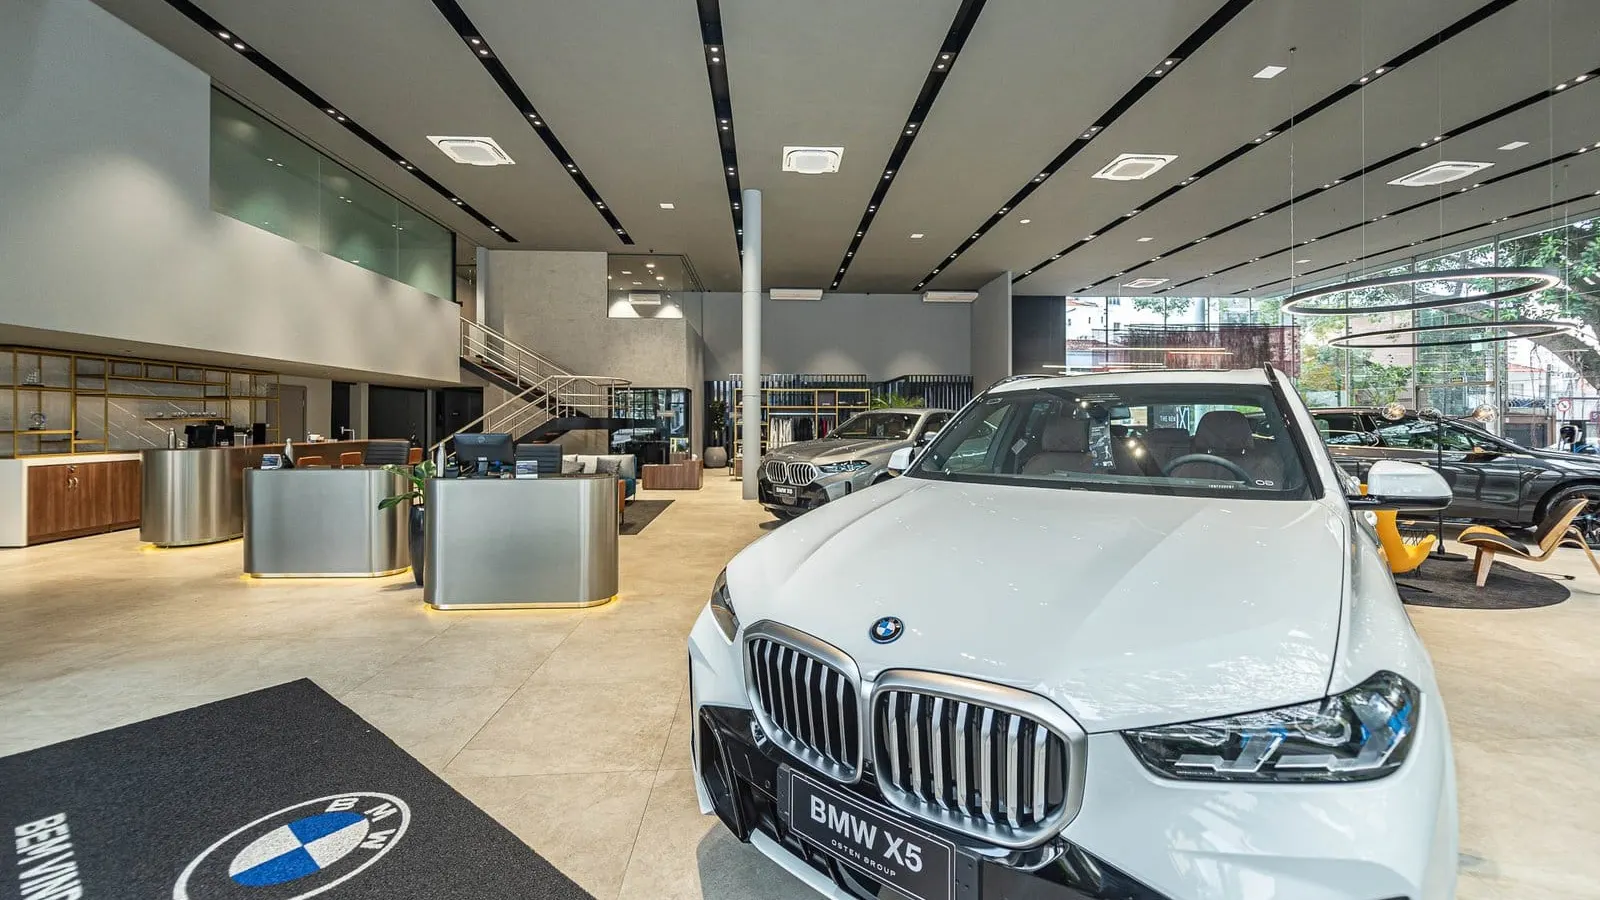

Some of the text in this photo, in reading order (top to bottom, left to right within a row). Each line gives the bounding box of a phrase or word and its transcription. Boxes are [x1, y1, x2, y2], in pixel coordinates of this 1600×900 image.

[14, 812, 73, 866] BEM
[324, 797, 398, 849] BMW
[810, 794, 923, 873] BMW X5
[831, 838, 897, 877] OSTEN GROUP
